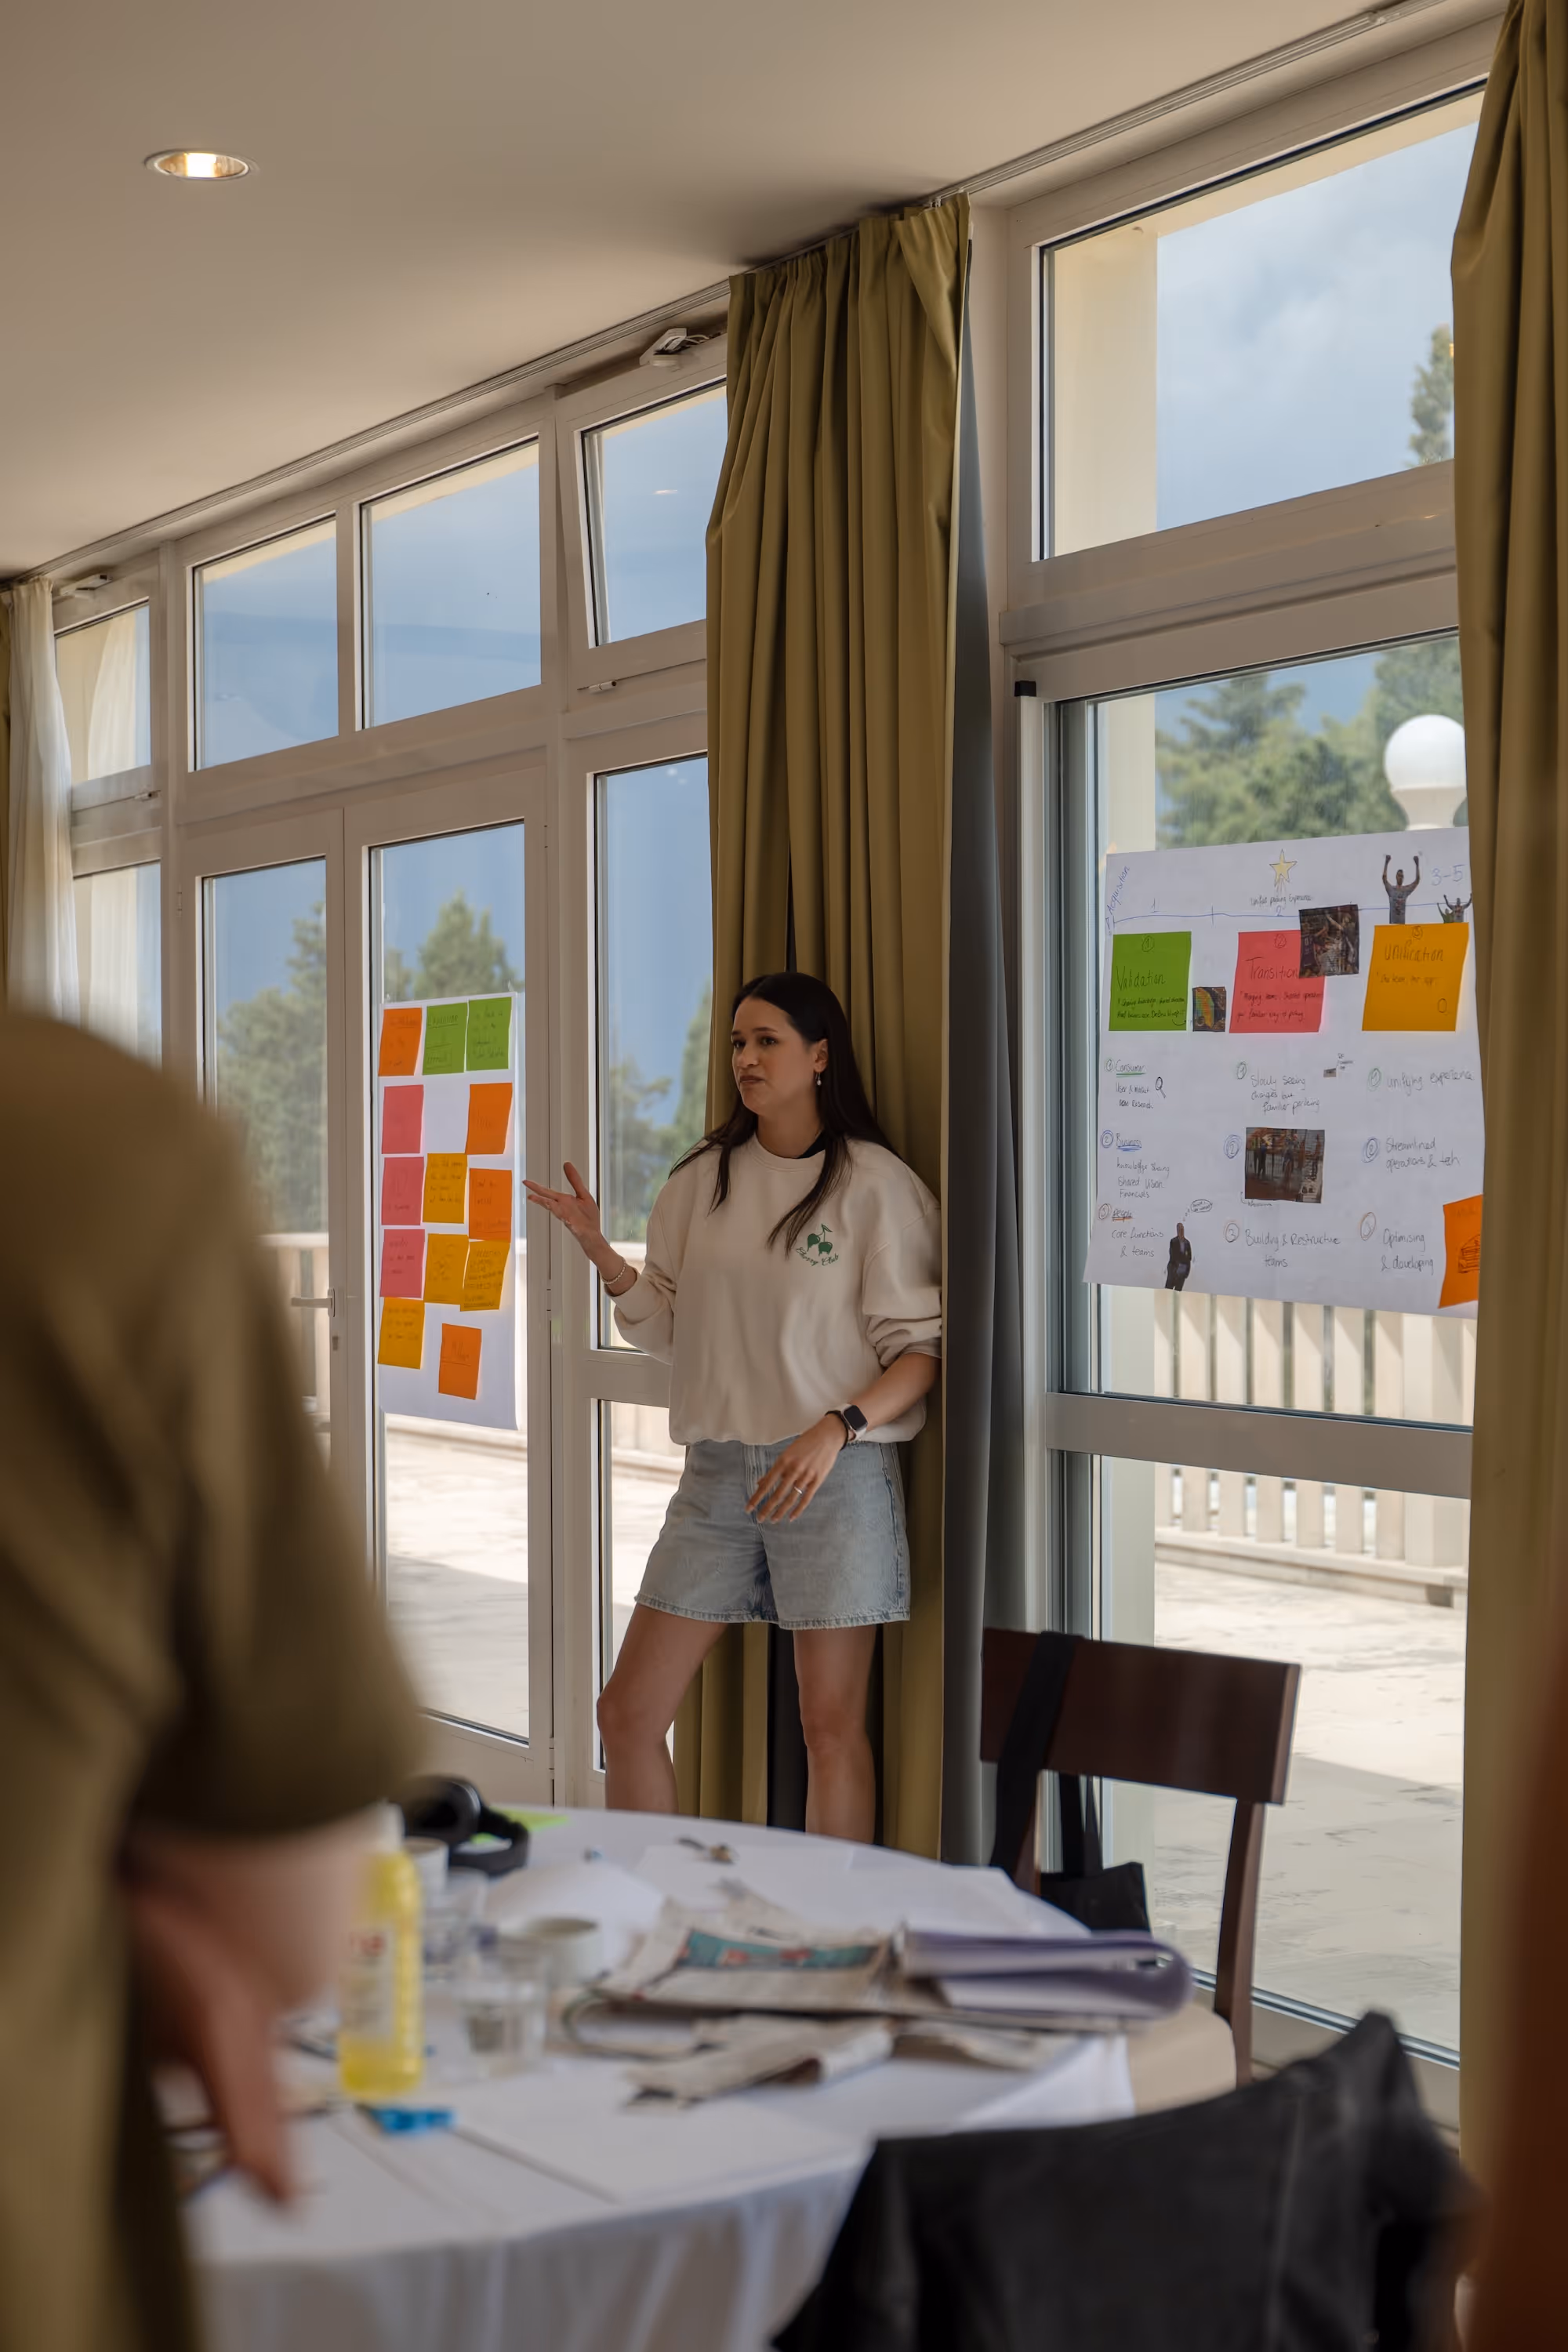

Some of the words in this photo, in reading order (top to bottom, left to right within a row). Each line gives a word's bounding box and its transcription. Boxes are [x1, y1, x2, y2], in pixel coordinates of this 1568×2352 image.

[1116, 965, 1167, 991] Validation
[1244, 956, 1299, 980] Transition
[1131, 1245, 1155, 1258] teams
[1383, 1229, 1425, 1252] Optimising
[821, 1252, 839, 1266] Club
